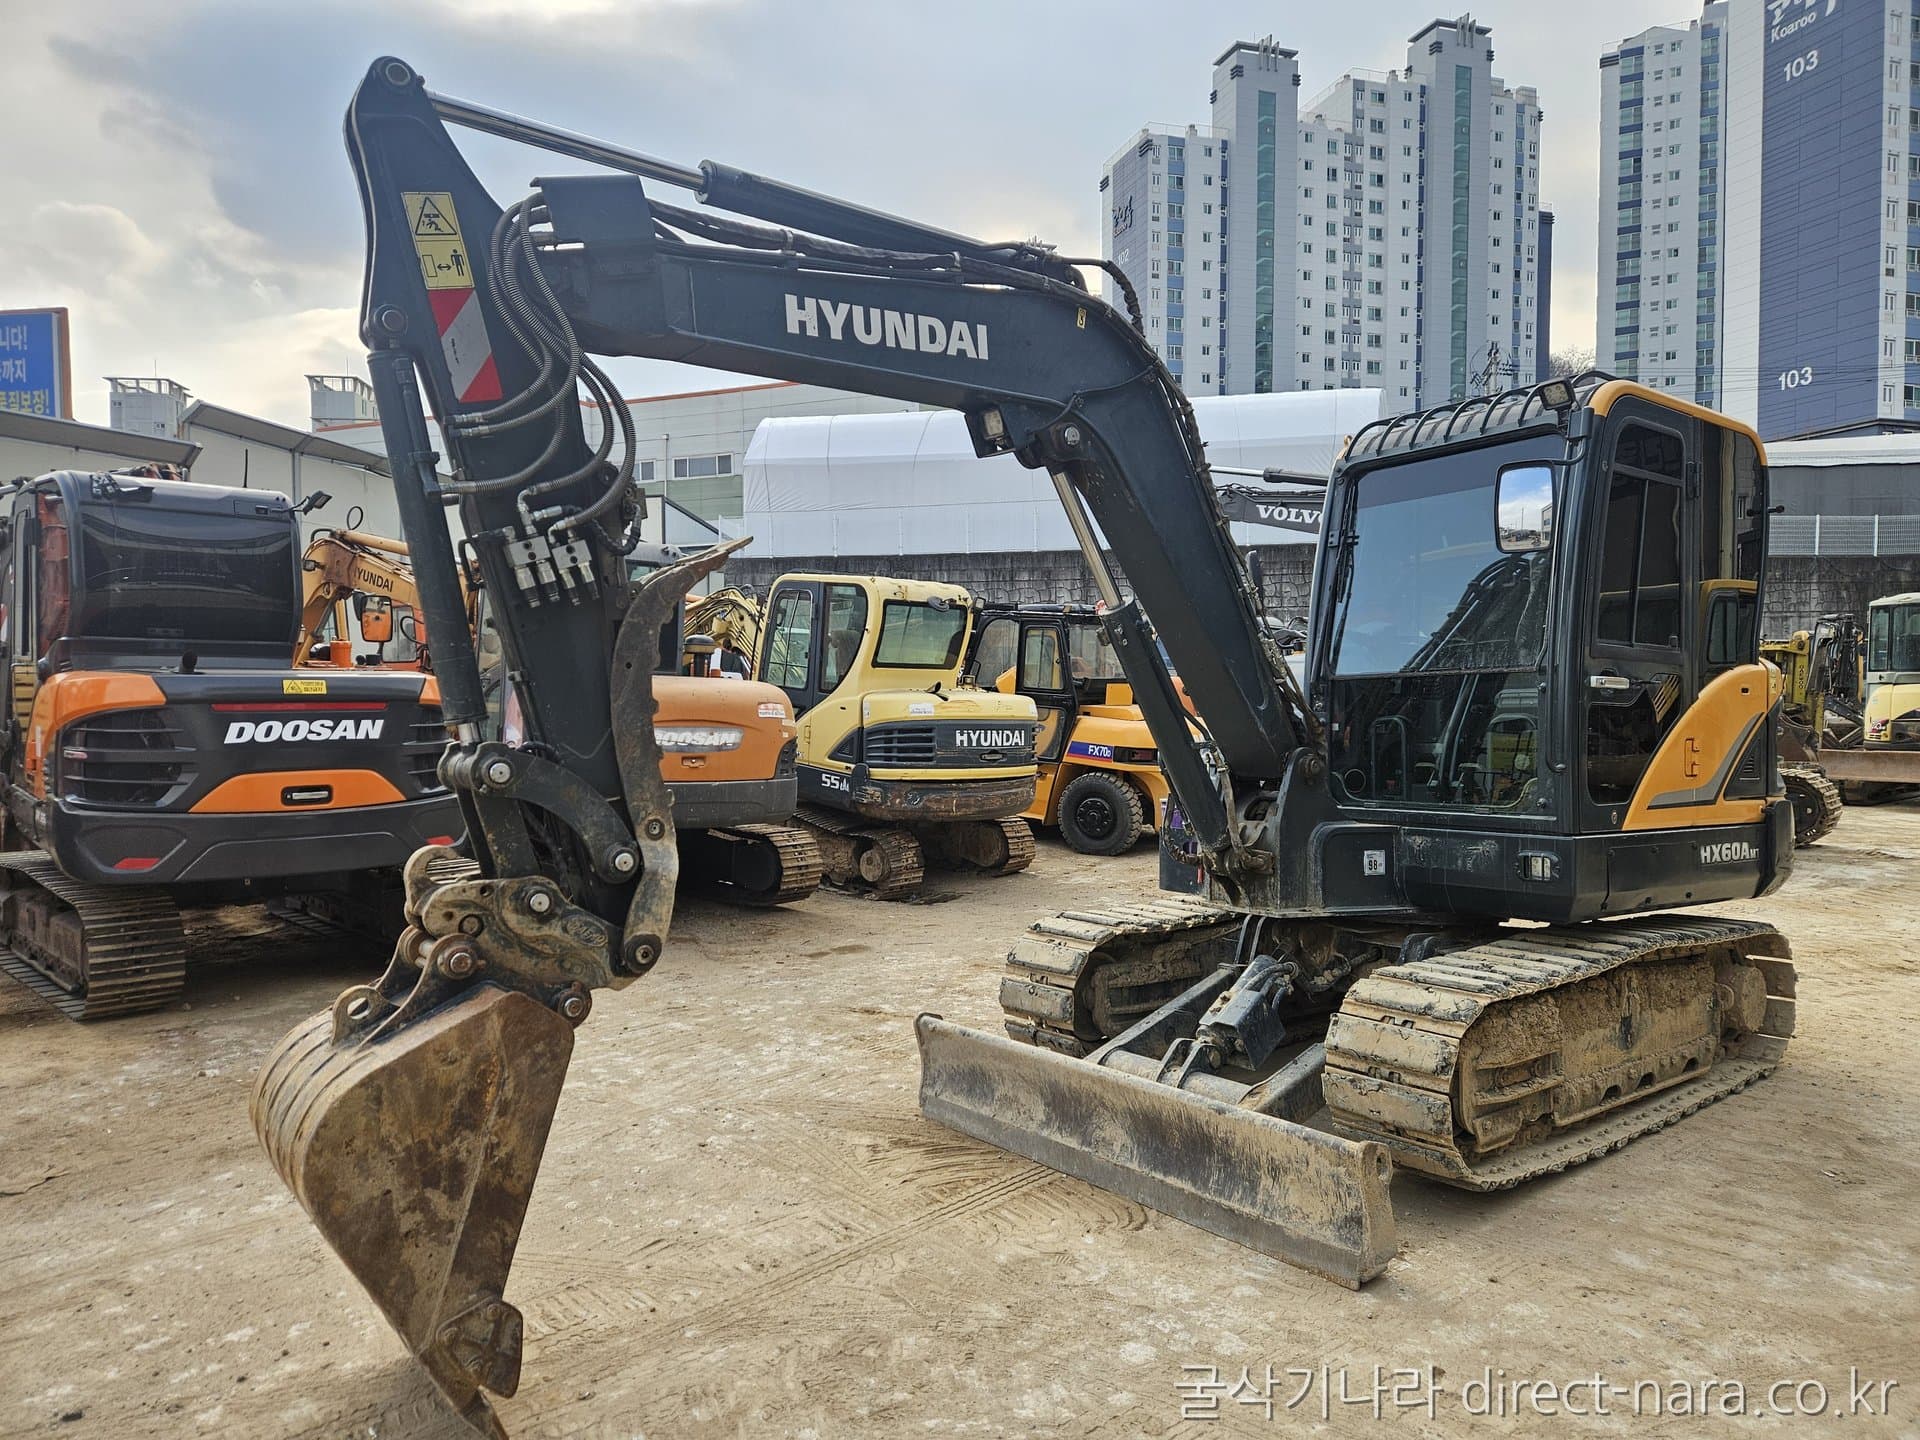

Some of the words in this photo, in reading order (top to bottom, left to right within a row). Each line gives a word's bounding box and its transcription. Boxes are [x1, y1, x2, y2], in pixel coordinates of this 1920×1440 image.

[1771, 12, 1817, 43] Koaroo
[1783, 50, 1819, 82] 103
[1117, 248, 1129, 266] 102
[784, 293, 989, 360] HYUNDAI
[0, 358, 26, 383] 까지
[1778, 367, 1812, 390] 103
[224, 720, 384, 744] DOOSAN
[955, 730, 1025, 747] HYUNDAI
[1368, 859, 1378, 871] 98
